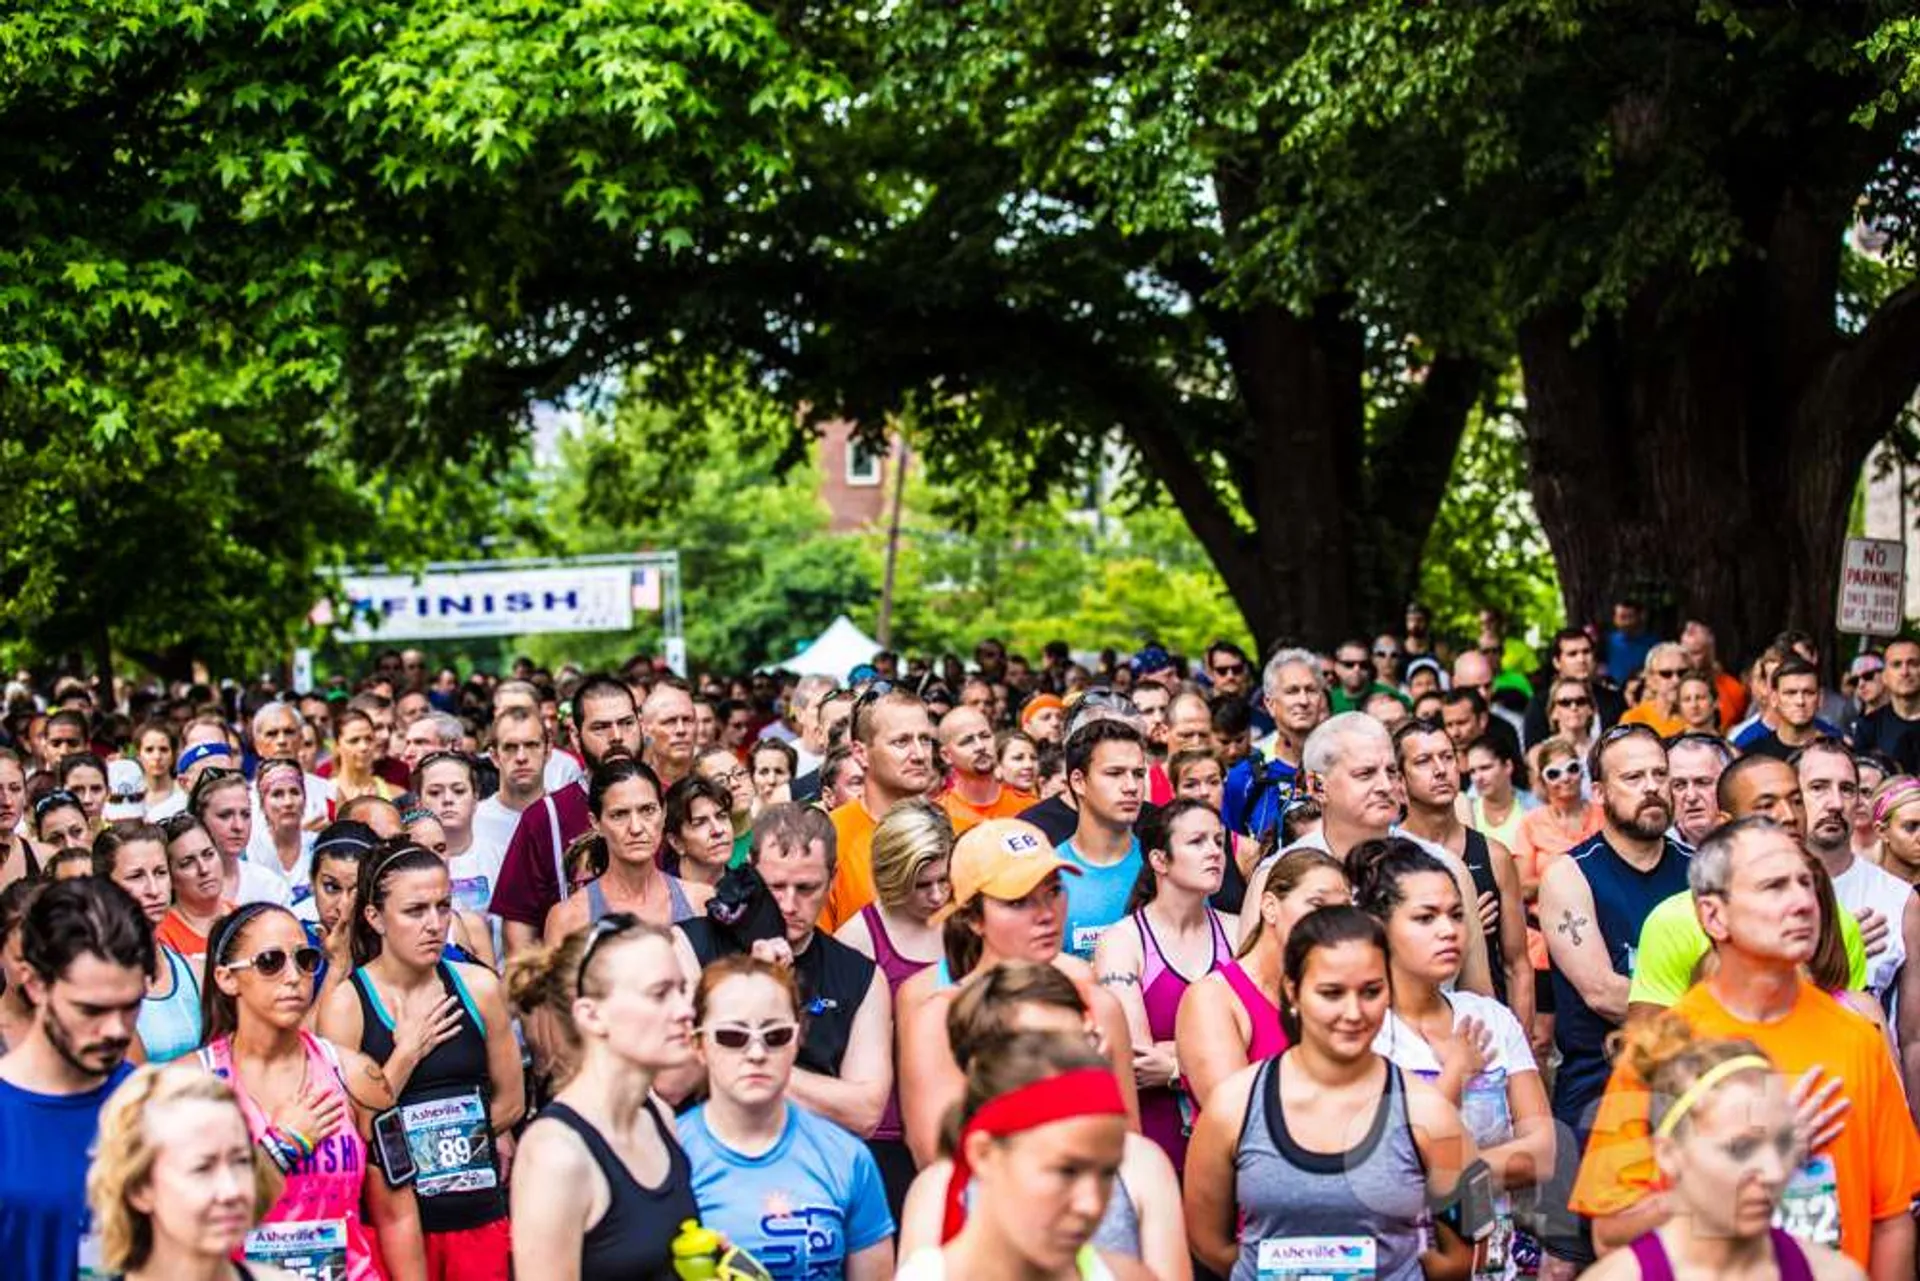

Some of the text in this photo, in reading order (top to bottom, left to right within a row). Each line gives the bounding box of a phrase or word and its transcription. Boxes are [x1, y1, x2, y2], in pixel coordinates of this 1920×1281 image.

[1863, 548, 1887, 567] NO
[1844, 567, 1900, 590] PARKING
[382, 590, 578, 617] FINISH
[1860, 608, 1895, 624] STREET
[1007, 835, 1038, 852] EB
[410, 1104, 461, 1122] Asheville
[438, 1137, 470, 1167] 89
[255, 1229, 314, 1243] Asheville
[1271, 1245, 1337, 1260] Asheville
